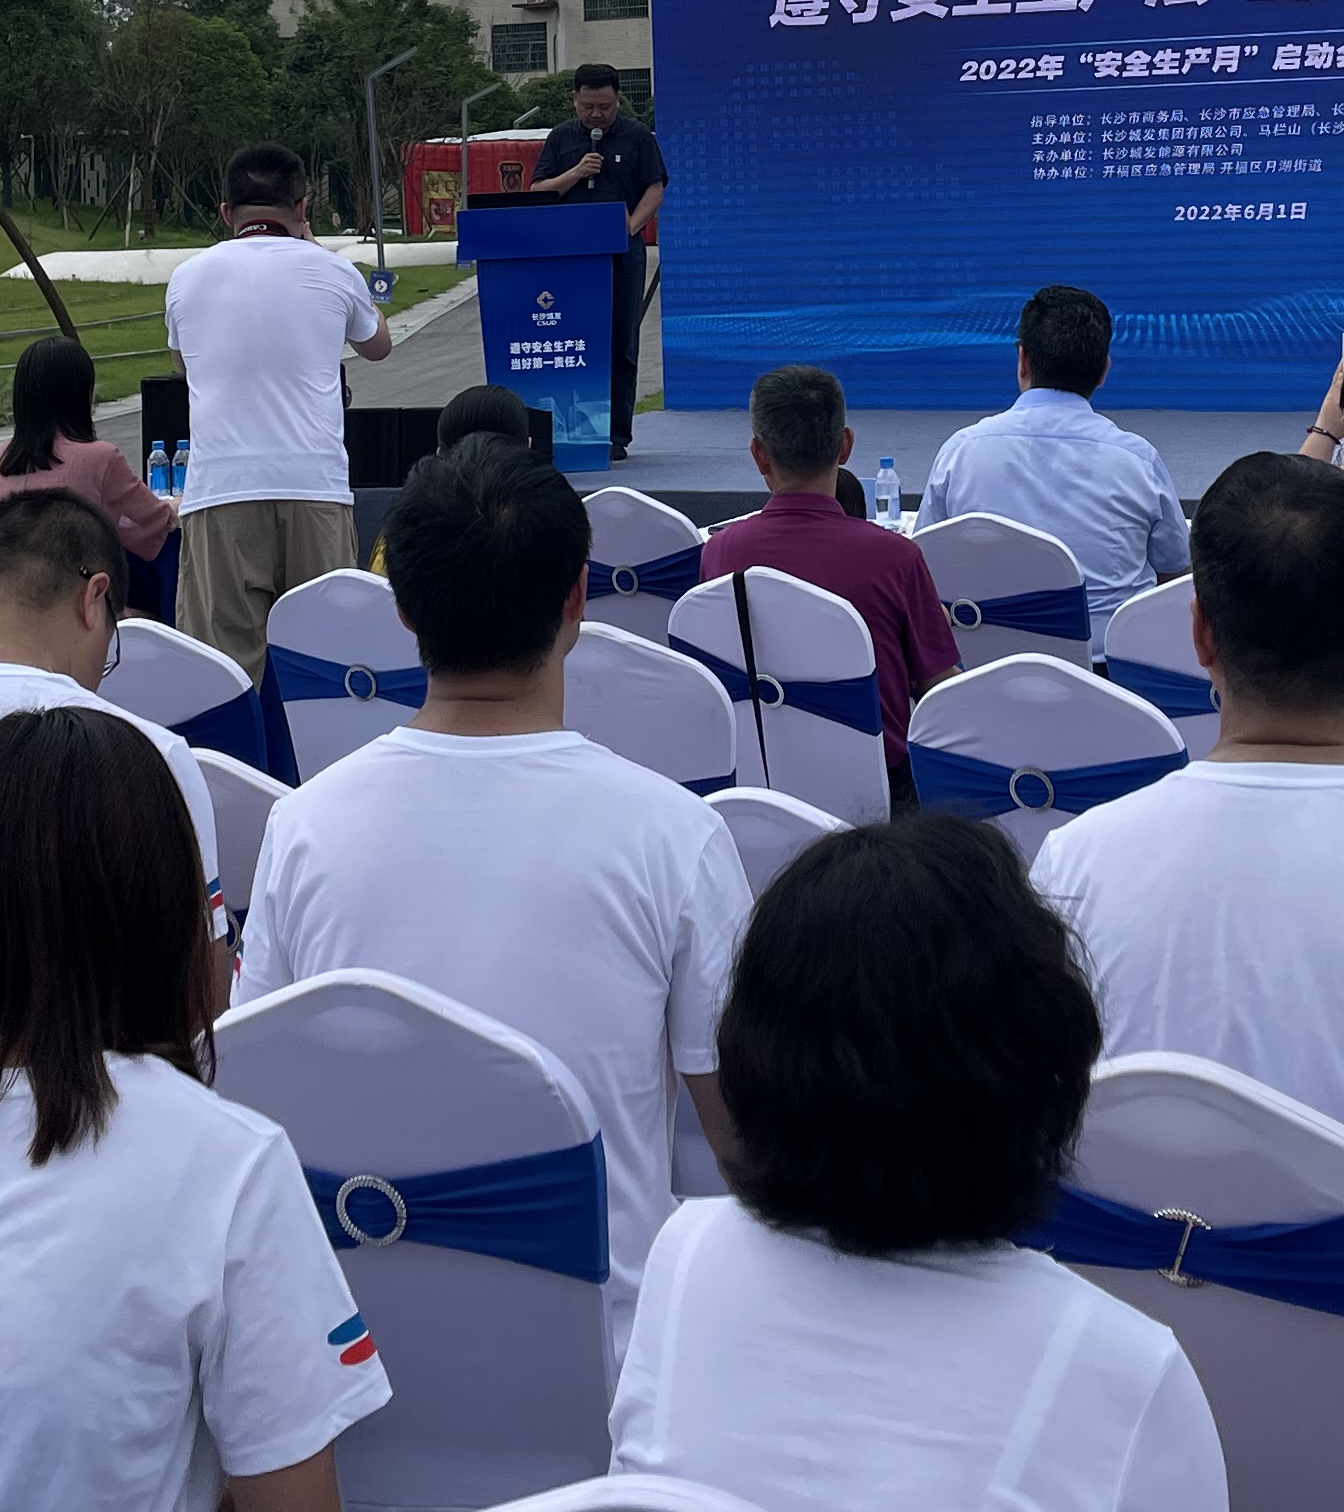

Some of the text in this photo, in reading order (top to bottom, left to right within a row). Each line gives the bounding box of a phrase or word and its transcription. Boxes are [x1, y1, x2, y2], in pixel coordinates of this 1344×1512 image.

[1173, 201, 1308, 222] 2022年6月1日
[510, 339, 586, 354] 遵守安全生产法
[510, 355, 587, 370] 当好第一责任人
